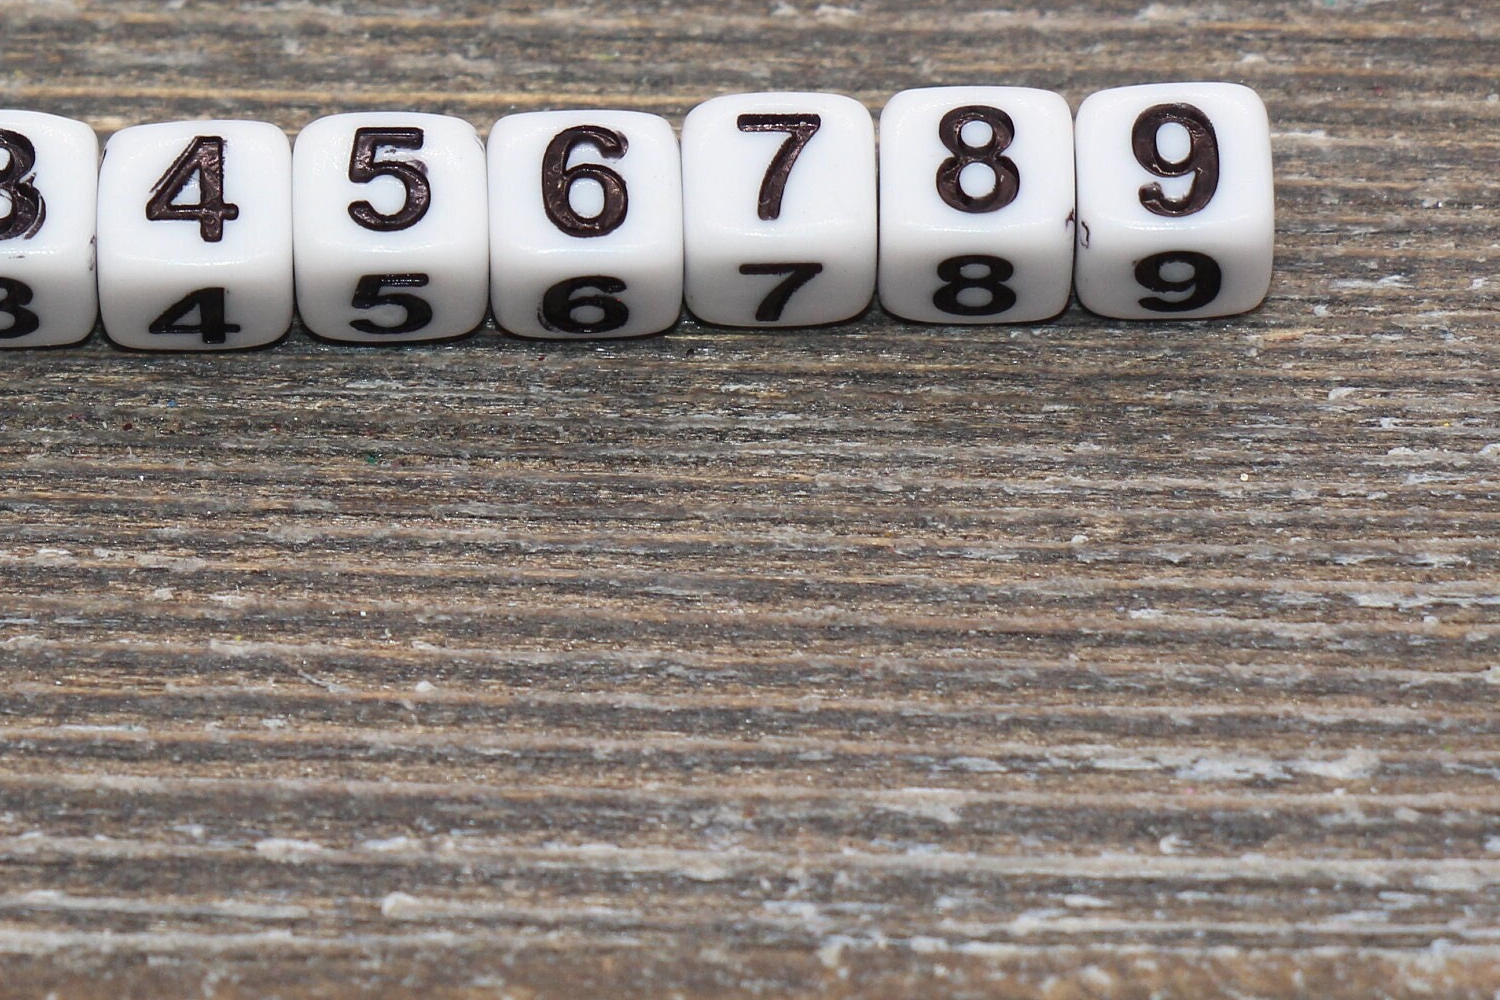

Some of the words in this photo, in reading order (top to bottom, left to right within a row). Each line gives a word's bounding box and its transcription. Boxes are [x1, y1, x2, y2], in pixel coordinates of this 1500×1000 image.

[144, 134, 241, 244] 4
[346, 125, 433, 234] 5
[540, 123, 630, 240] 6
[735, 112, 823, 222] 7
[934, 103, 1022, 216] 8
[1130, 101, 1221, 219] 9
[148, 287, 240, 343] 4
[349, 273, 431, 334] 5
[540, 276, 629, 333] 6
[738, 263, 822, 322] 7
[932, 255, 1017, 316] 8
[1132, 251, 1222, 312] 9
